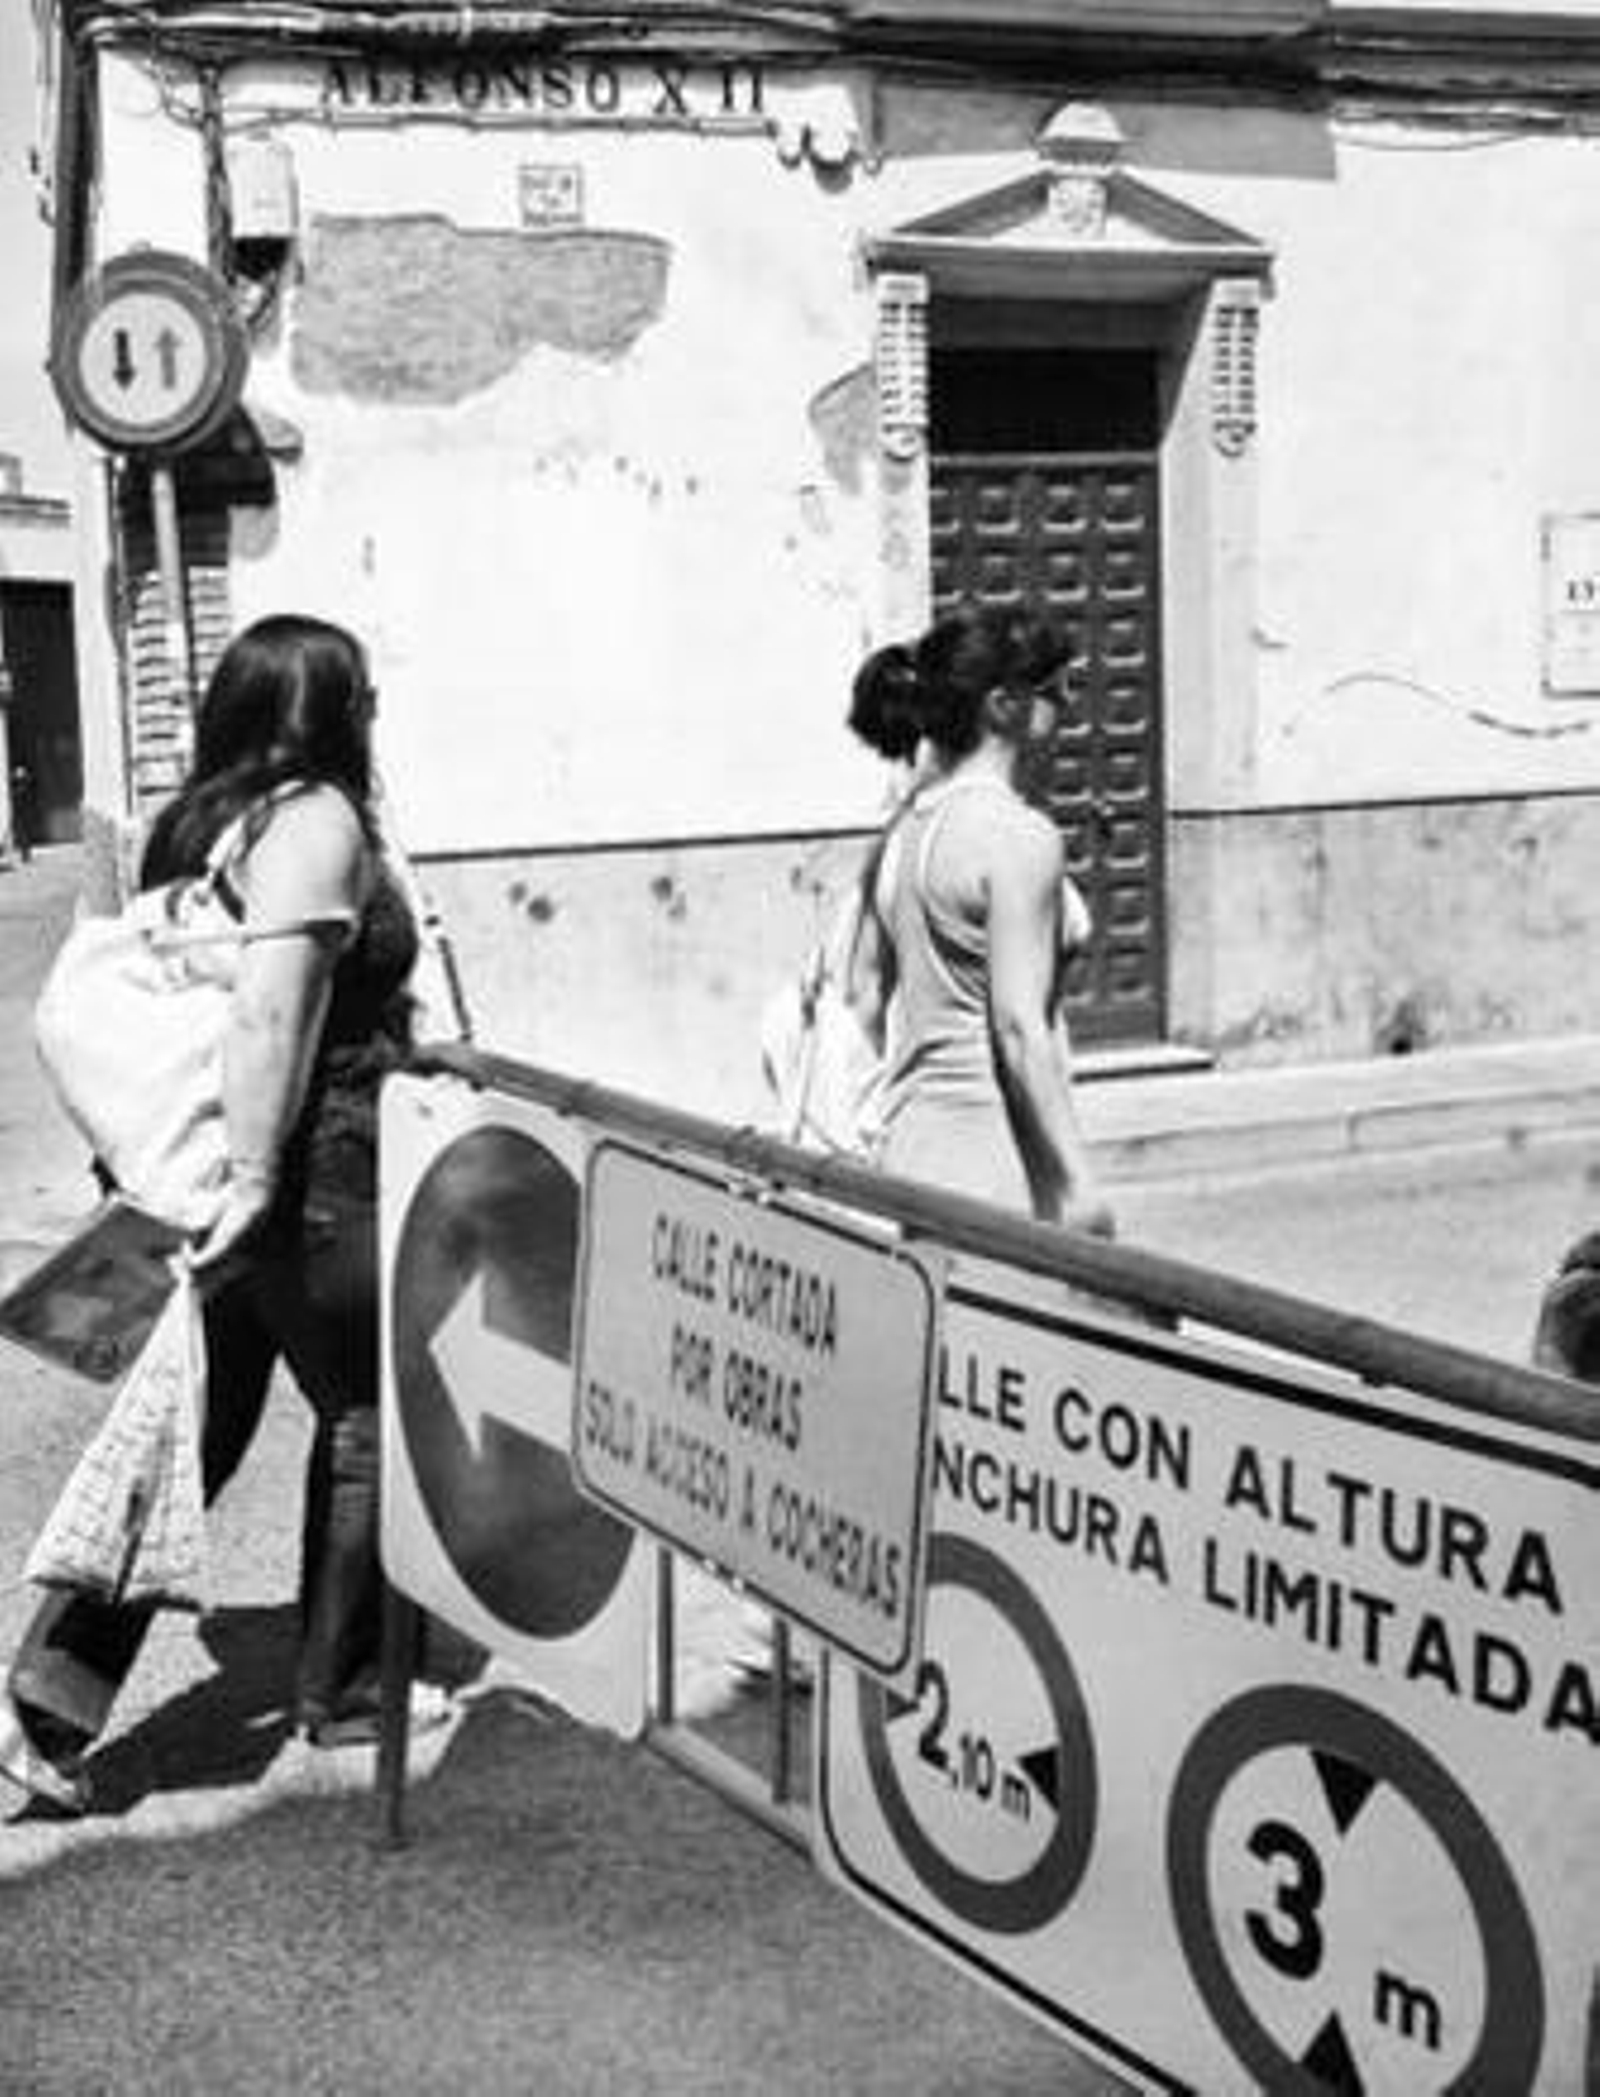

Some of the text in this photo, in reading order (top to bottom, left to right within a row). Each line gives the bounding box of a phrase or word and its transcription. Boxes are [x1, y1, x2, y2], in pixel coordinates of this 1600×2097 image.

[321, 62, 621, 114] ALFONSO
[652, 1212, 836, 1356] CALLE CORTADA
[671, 1322, 800, 1451] POR OBRAS
[647, 1412, 729, 1522] ACCESO
[742, 1464, 754, 1530] A
[767, 1482, 899, 1619] COCHERAS
[938, 1343, 1564, 1616] LLE CON ALTURA
[930, 1432, 1600, 1798] NCHURA LIMITADA
[1244, 1818, 1442, 2051] 3 m
